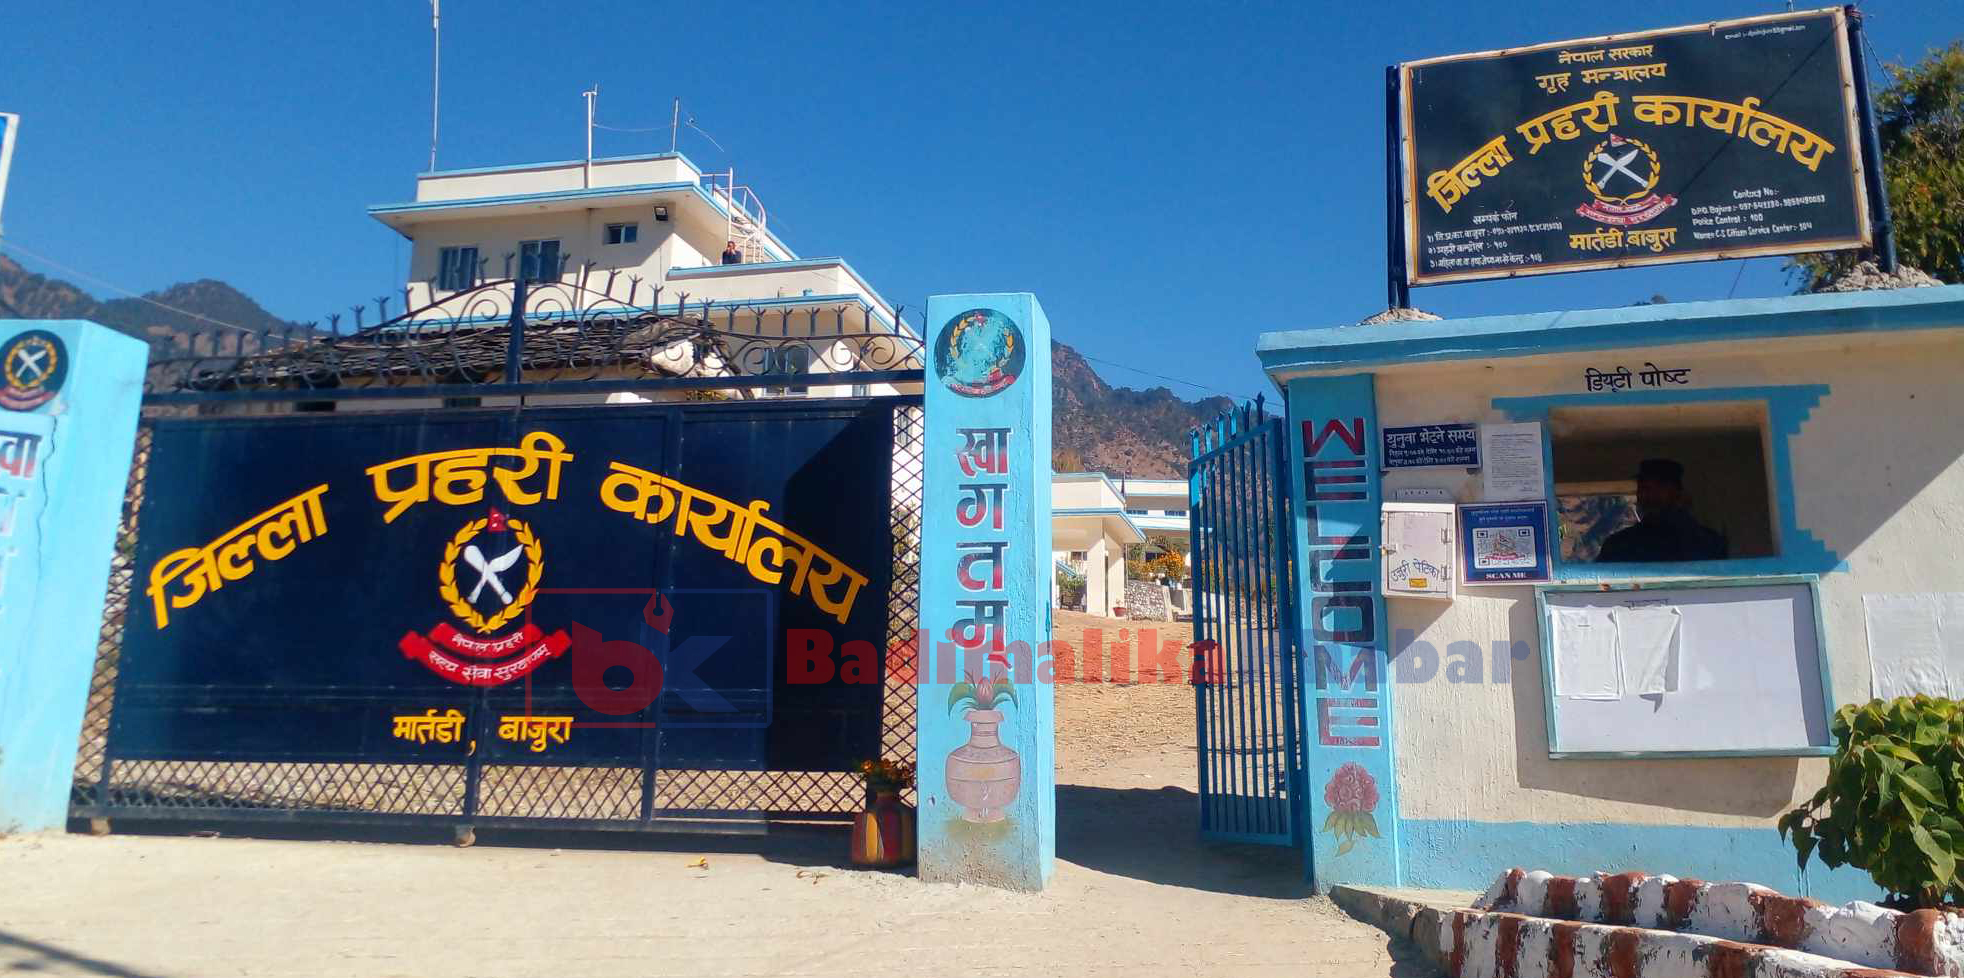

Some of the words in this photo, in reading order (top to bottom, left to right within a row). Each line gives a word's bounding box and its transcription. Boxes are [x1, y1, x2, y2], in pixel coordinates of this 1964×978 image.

[1559, 49, 1605, 64] नेपाल
[1608, 45, 1654, 61] सरकार
[1581, 63, 1667, 83] मन्त्रालय
[1426, 135, 1514, 214] जिल्ला
[1516, 91, 1620, 155] प्रहरी
[1631, 96, 1836, 173] कार्यालय
[1715, 215, 1740, 225] Control
[1750, 213, 1763, 222] 100
[1628, 227, 1677, 252] बाजुरा
[1639, 362, 1691, 387] पोष्ट
[1448, 430, 1475, 443] समय
[146, 483, 330, 629] जिल्ला
[366, 431, 574, 524] प्रहरी
[600, 461, 870, 624] कार्यालय
[1302, 417, 1381, 747] WELCOME
[461, 665, 493, 681] सेवा
[498, 716, 574, 752] बाजुरा
